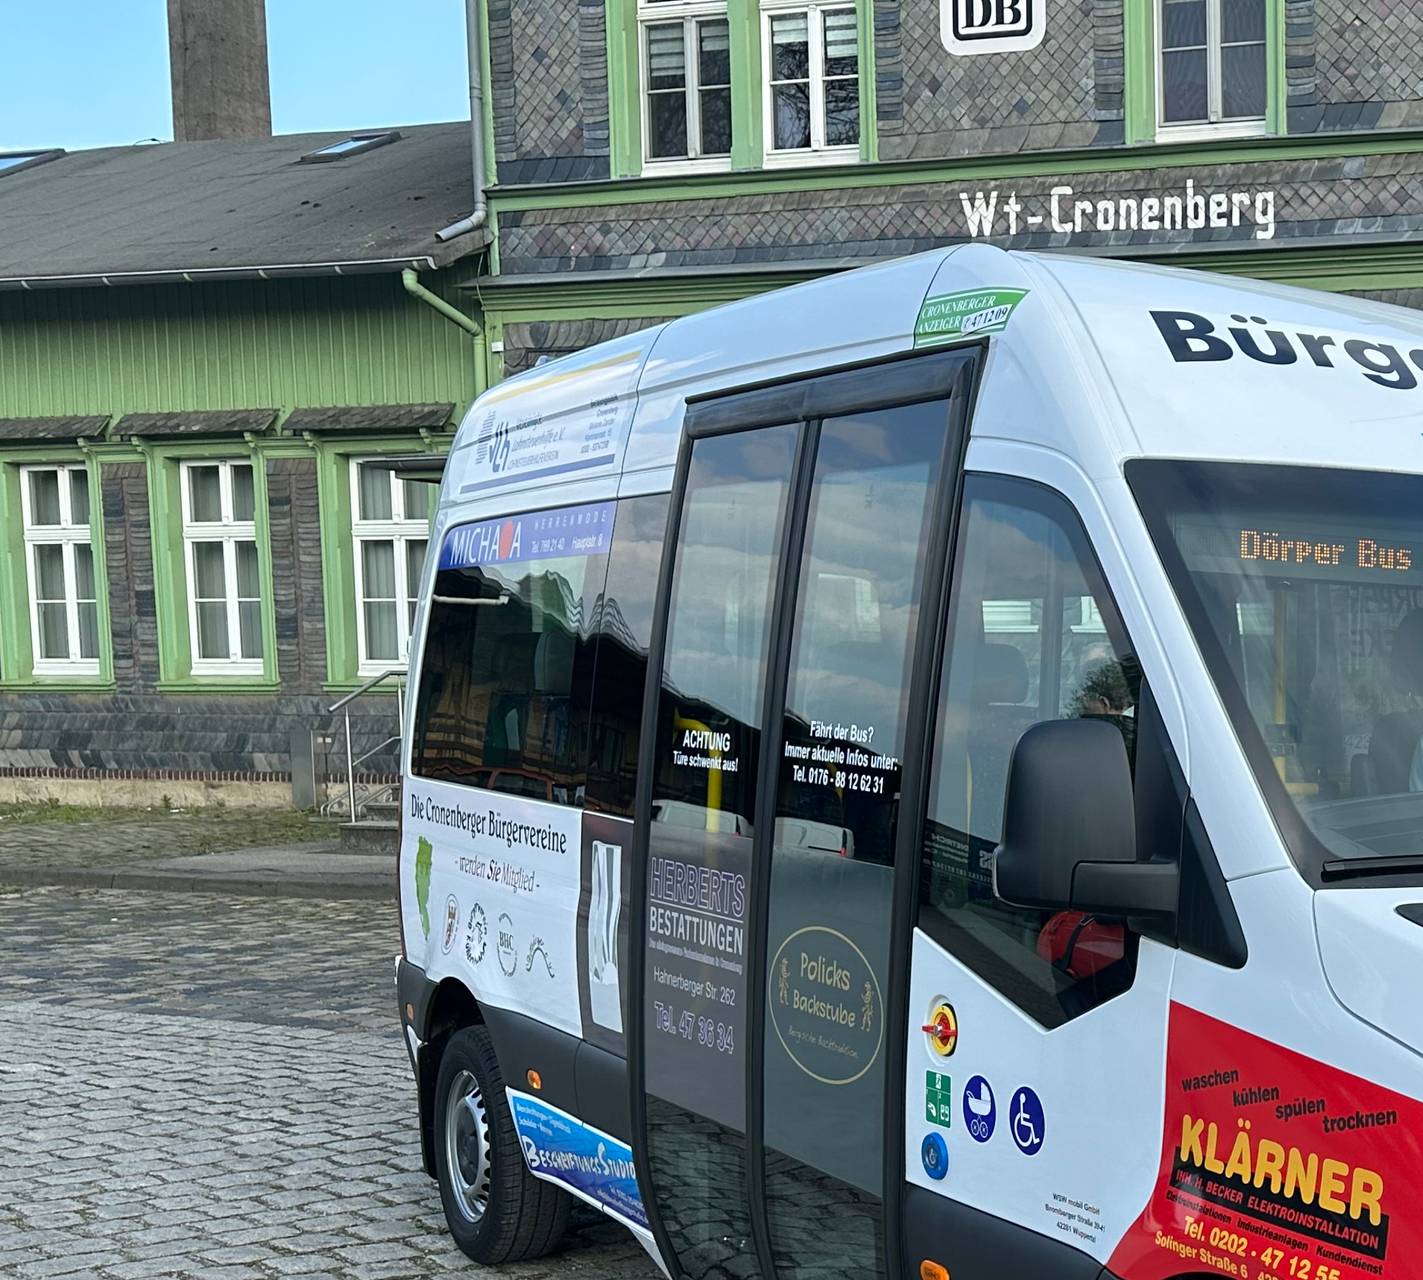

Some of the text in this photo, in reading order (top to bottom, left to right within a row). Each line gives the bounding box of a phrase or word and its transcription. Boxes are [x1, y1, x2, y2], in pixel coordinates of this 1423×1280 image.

[961, 0, 1022, 29] DB
[959, 179, 1274, 240] Wt-Cronenberg
[919, 315, 960, 333] ANZEIGER
[921, 295, 996, 319] CRONENBERGER
[1240, 530, 1412, 570] Dörper Bus
[682, 729, 731, 752] ACHTUNG
[809, 720, 874, 743] Fährt der Bus?
[672, 751, 738, 772] Türe schwenkt aus!
[784, 741, 898, 771] Immer aktuelle Infos unter:
[792, 765, 807, 783] Tel.
[808, 767, 829, 786] 0176
[834, 771, 847, 789] 88
[848, 773, 858, 791] 12
[860, 774, 872, 792] 62
[873, 776, 884, 794] 31
[411, 793, 567, 854] Die Cronenberger Bürgervereine
[458, 855, 486, 879] werden
[486, 859, 501, 882] Sie
[501, 863, 536, 894] Mitglied
[650, 857, 745, 917] HERBERTS
[499, 931, 515, 951] BHC
[650, 906, 744, 956] BESTATTUNGEN
[653, 965, 736, 1006] Hahnerberger Str. 262
[800, 952, 850, 991] Policks
[654, 1000, 734, 1055] Tel. 47 36 34
[793, 989, 856, 1028] Backstube
[1181, 1069, 1239, 1092] waschen
[1232, 1084, 1279, 1107] kühlen
[1275, 1097, 1326, 1122] spülen
[1322, 1109, 1397, 1133] trocknen
[1180, 1114, 1384, 1226] KLÄRNER
[1175, 1169, 1379, 1249] INH. H. BECKER ELEKTROINSTALLATION
[1154, 1229, 1248, 1279] Solinger Straße 6
[1183, 1215, 1341, 1280] Tel. 0202 47 12 55
[1237, 1217, 1309, 1251] Industrieanlagen
[1316, 1245, 1383, 1276] Kundendienst
